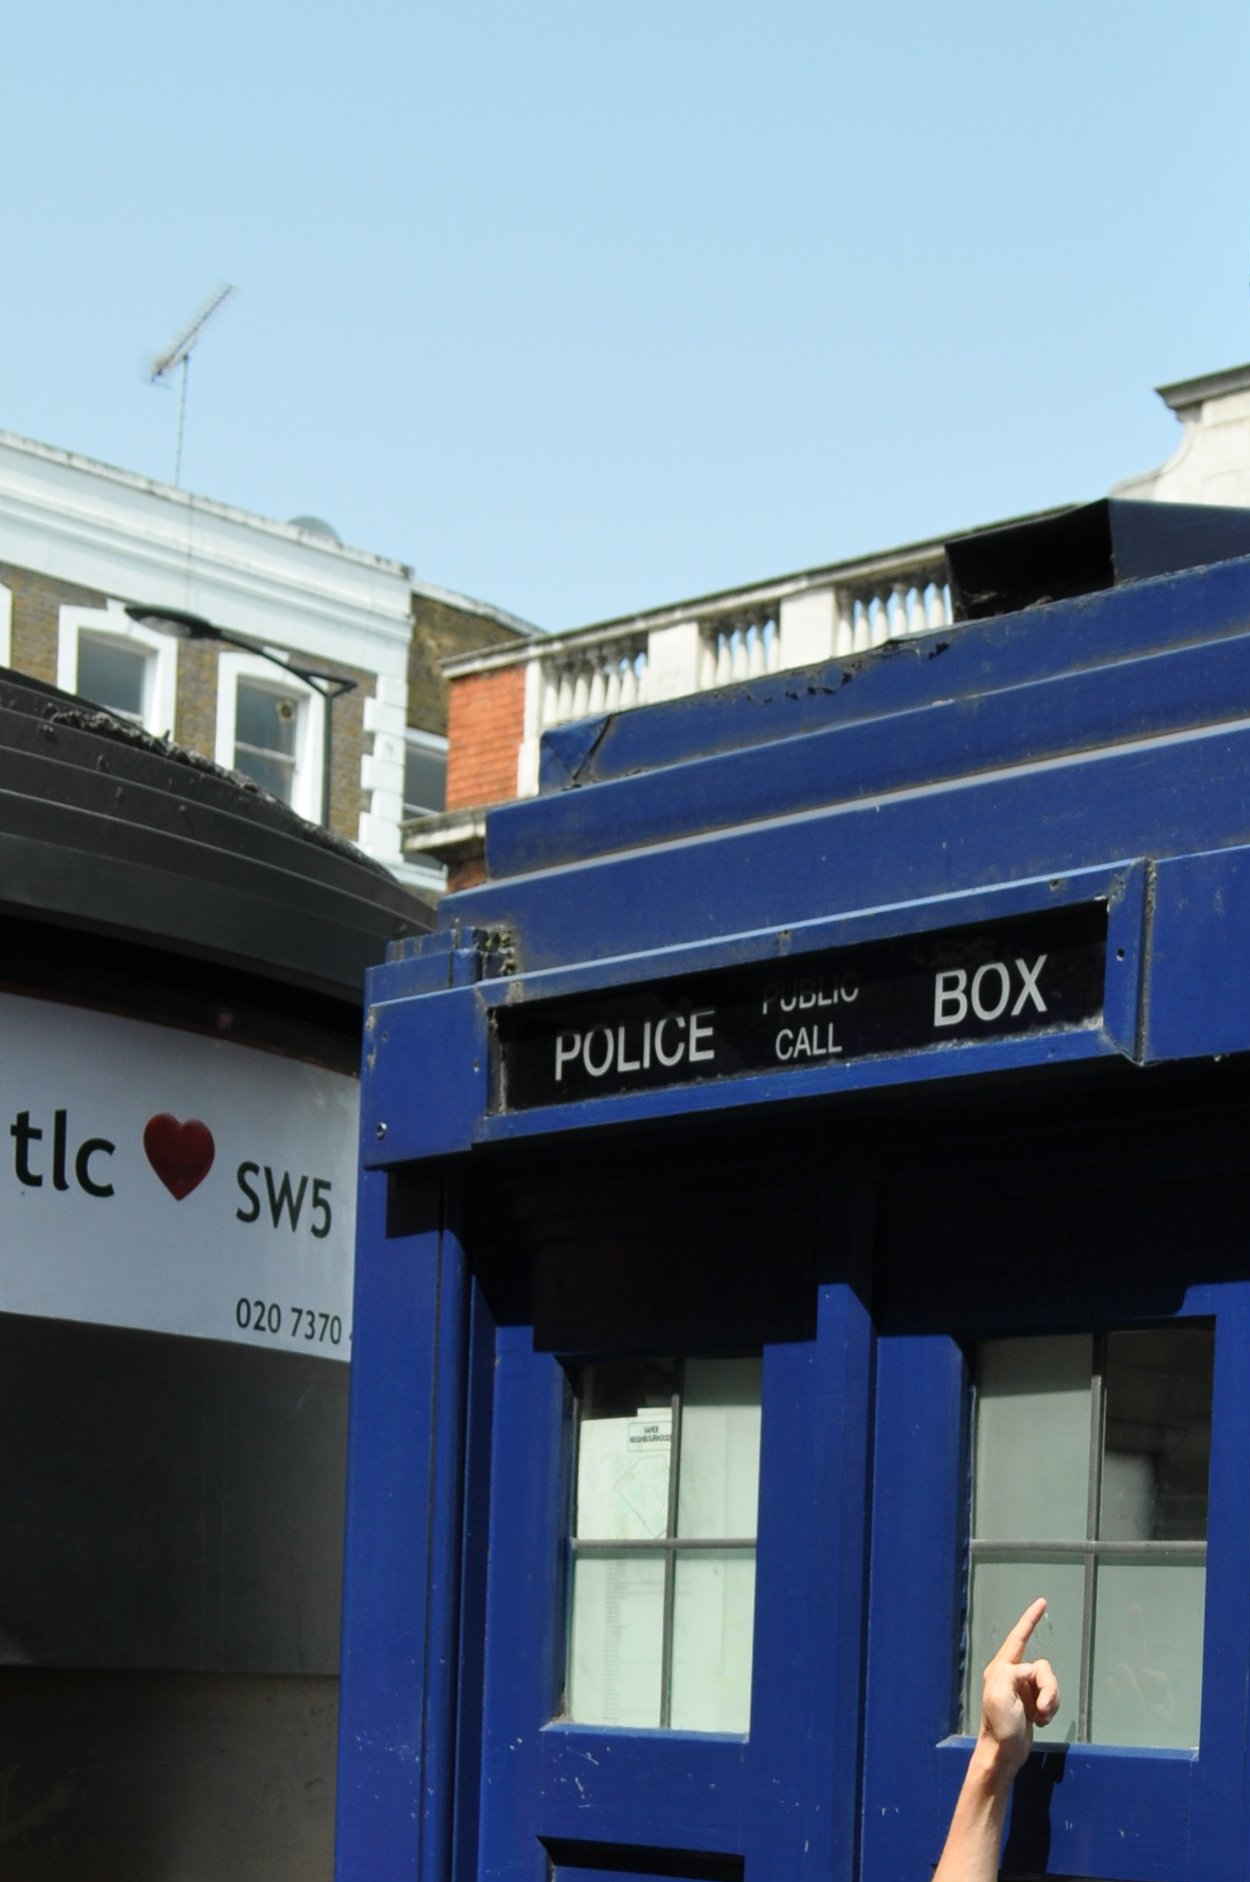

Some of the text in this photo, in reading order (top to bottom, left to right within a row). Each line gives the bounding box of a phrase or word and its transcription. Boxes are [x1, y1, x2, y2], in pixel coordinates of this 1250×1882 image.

[933, 954, 1049, 1028] BOX
[554, 1007, 716, 1082] POLICE
[774, 1023, 843, 1061] CALL
[10, 1108, 333, 1240] tlc SW5
[236, 1298, 342, 1345] 020 7370
